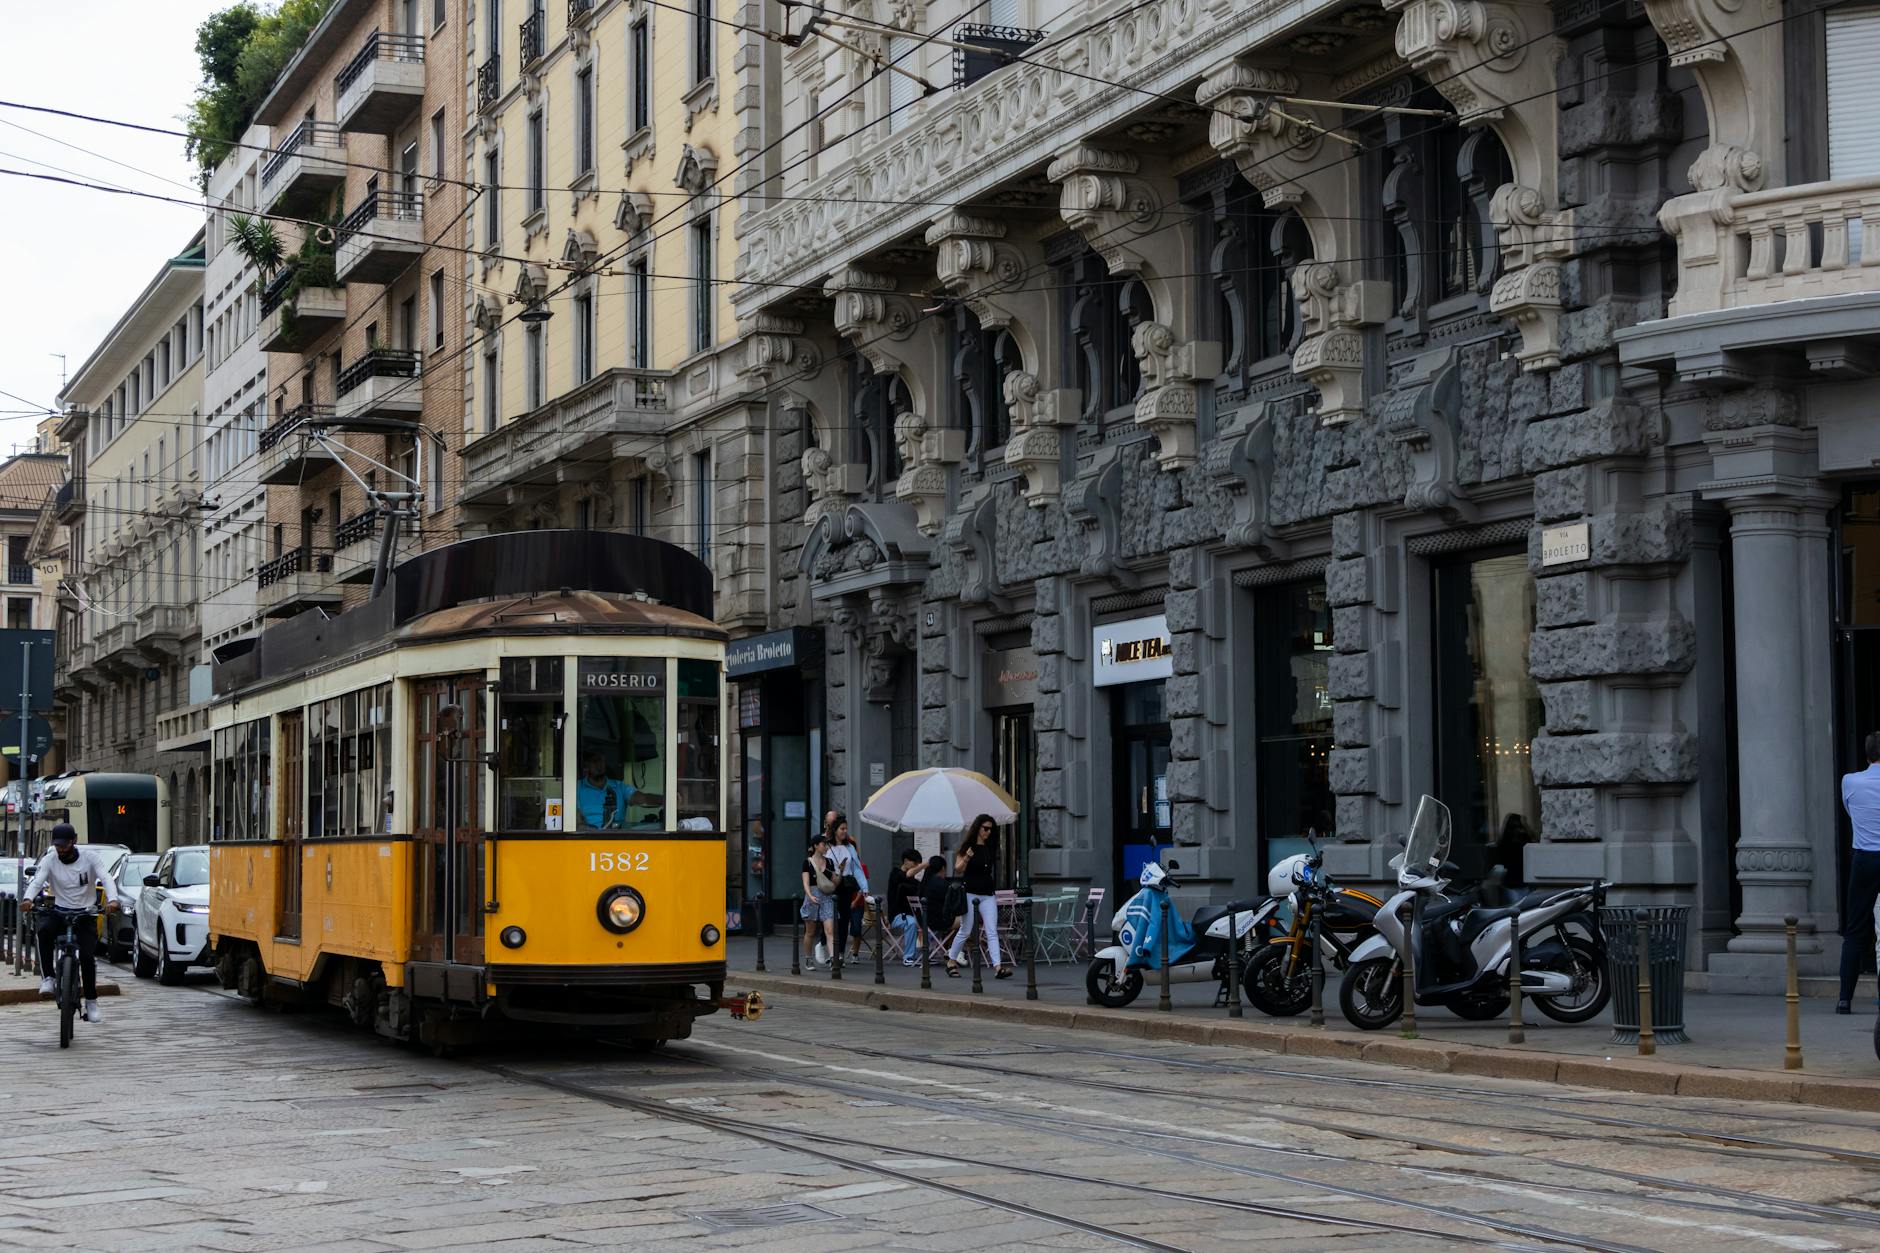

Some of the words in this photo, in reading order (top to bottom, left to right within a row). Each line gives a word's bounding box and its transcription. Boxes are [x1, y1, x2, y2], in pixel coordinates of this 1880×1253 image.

[1559, 531, 1568, 539] VIA
[41, 564, 59, 575] 101
[725, 646, 756, 668] rtoleria
[757, 641, 792, 661] Broletto
[586, 673, 657, 688] ROSERIO
[117, 805, 126, 815] 14
[551, 805, 558, 817] 6
[551, 818, 557, 829] 1
[590, 851, 650, 872] 1582
